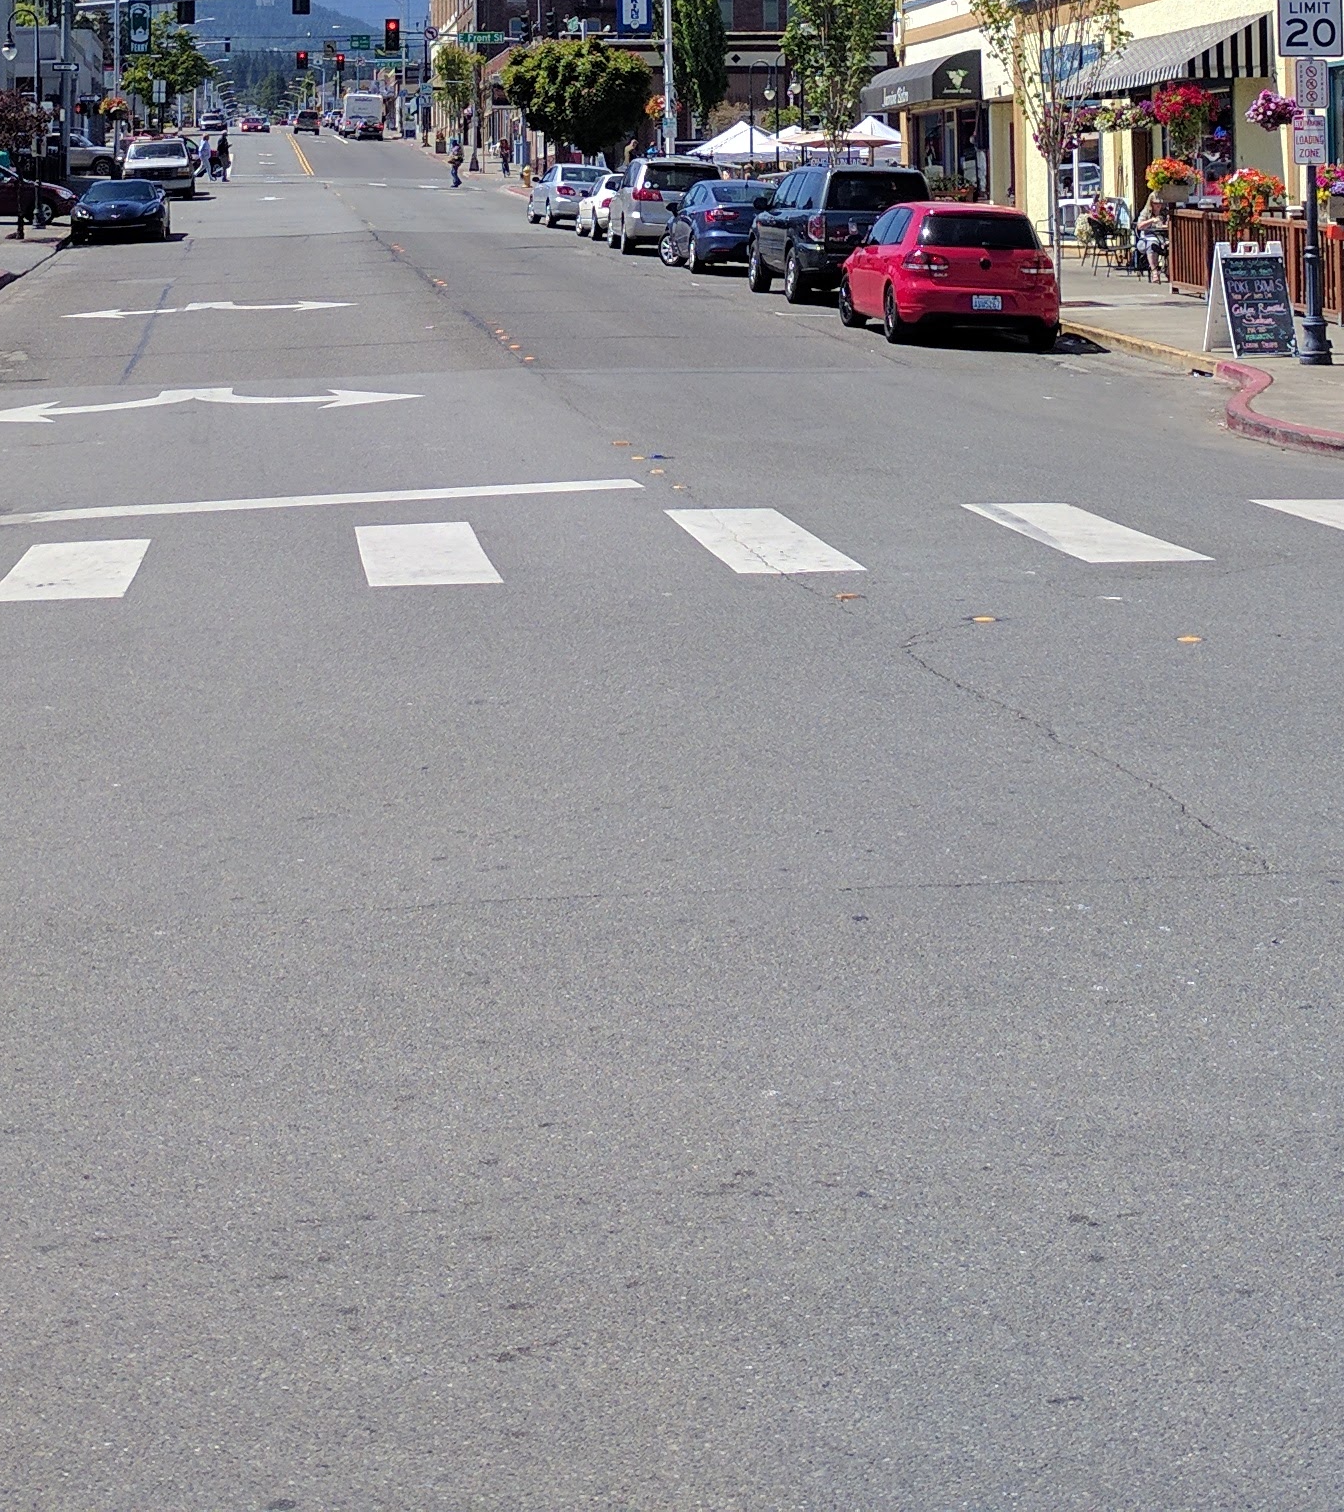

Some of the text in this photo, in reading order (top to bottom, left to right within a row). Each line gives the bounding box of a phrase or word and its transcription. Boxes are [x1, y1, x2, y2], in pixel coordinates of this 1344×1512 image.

[1289, 1, 1331, 14] LIMIT
[458, 32, 504, 43] E Front St
[1285, 17, 1336, 48] 20
[1296, 134, 1325, 145] LOADING
[1299, 148, 1321, 158] ZONE
